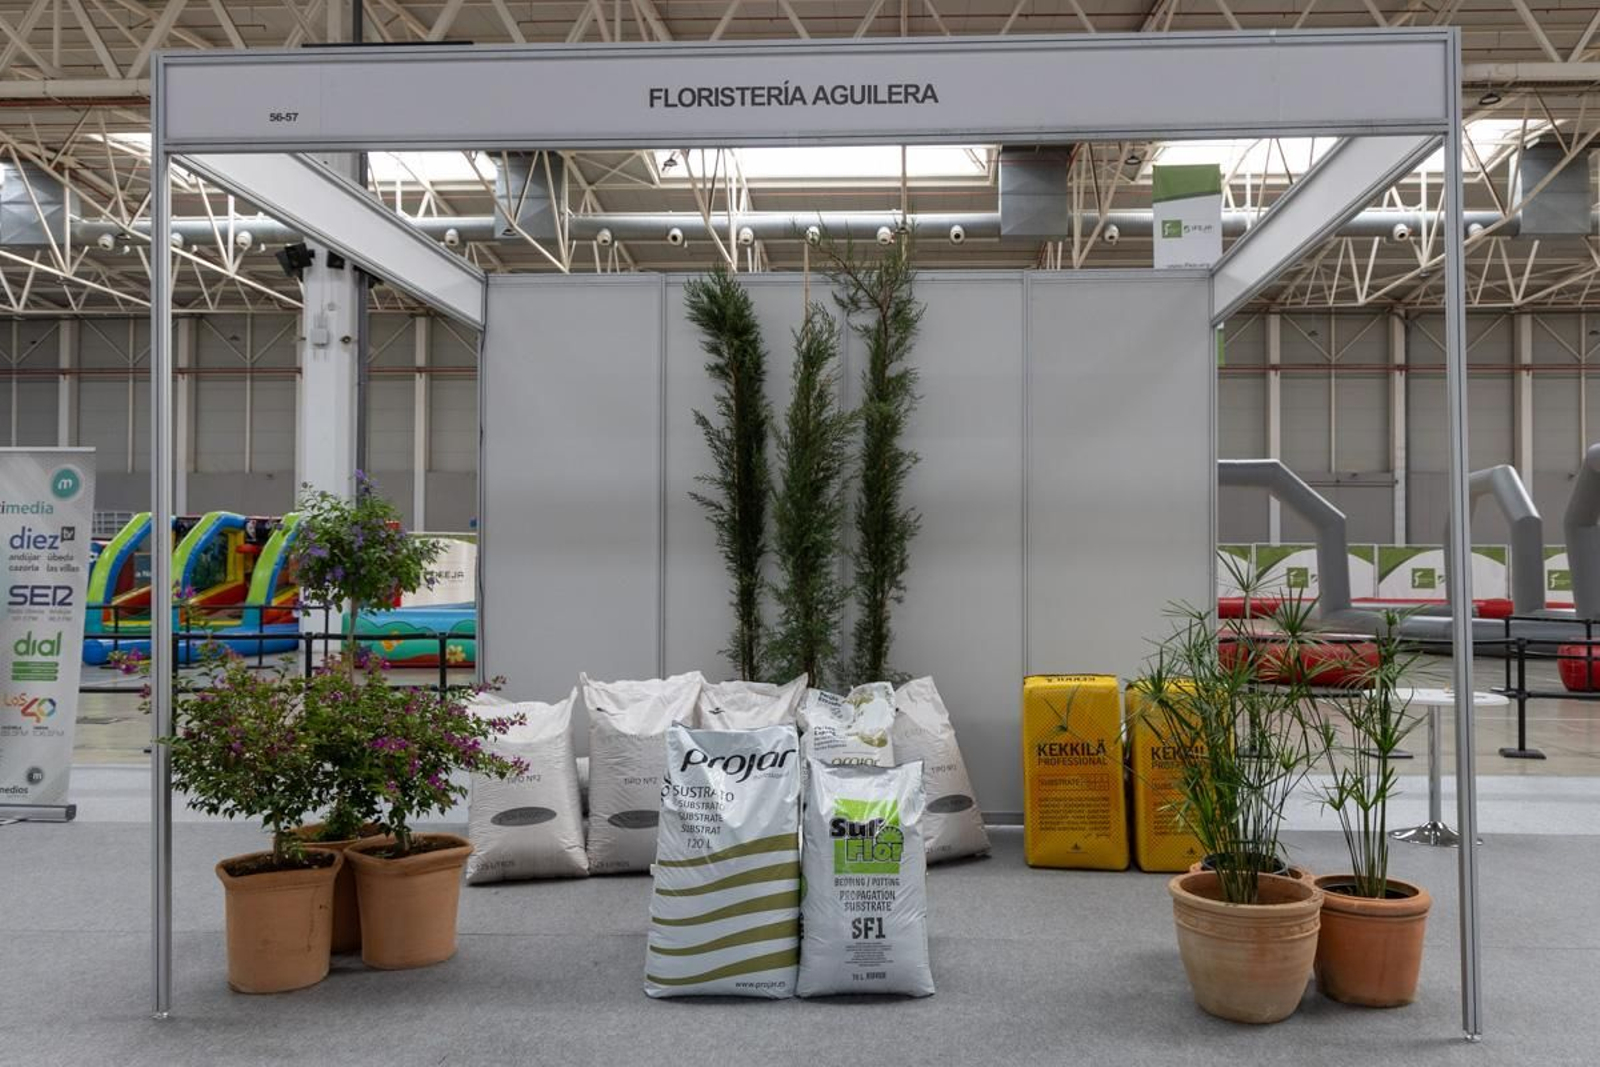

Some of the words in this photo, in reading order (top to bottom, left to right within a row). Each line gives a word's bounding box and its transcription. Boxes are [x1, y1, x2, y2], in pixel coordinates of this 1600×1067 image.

[649, 80, 807, 108] FLORISTERÍA
[811, 83, 939, 106] AGUILERA
[269, 112, 299, 122] 56-57
[9, 525, 60, 550] diez
[14, 630, 62, 656] dial
[1038, 739, 1106, 757] KEKKILÄ
[1037, 757, 1108, 766] PROFESSIONAL
[679, 813, 724, 822] SUBSTRATE
[681, 825, 721, 835] SUBSTRAT
[839, 890, 896, 901] PROPAGATION
[844, 901, 892, 912] SUBSTRATE
[851, 917, 886, 940] SF1
